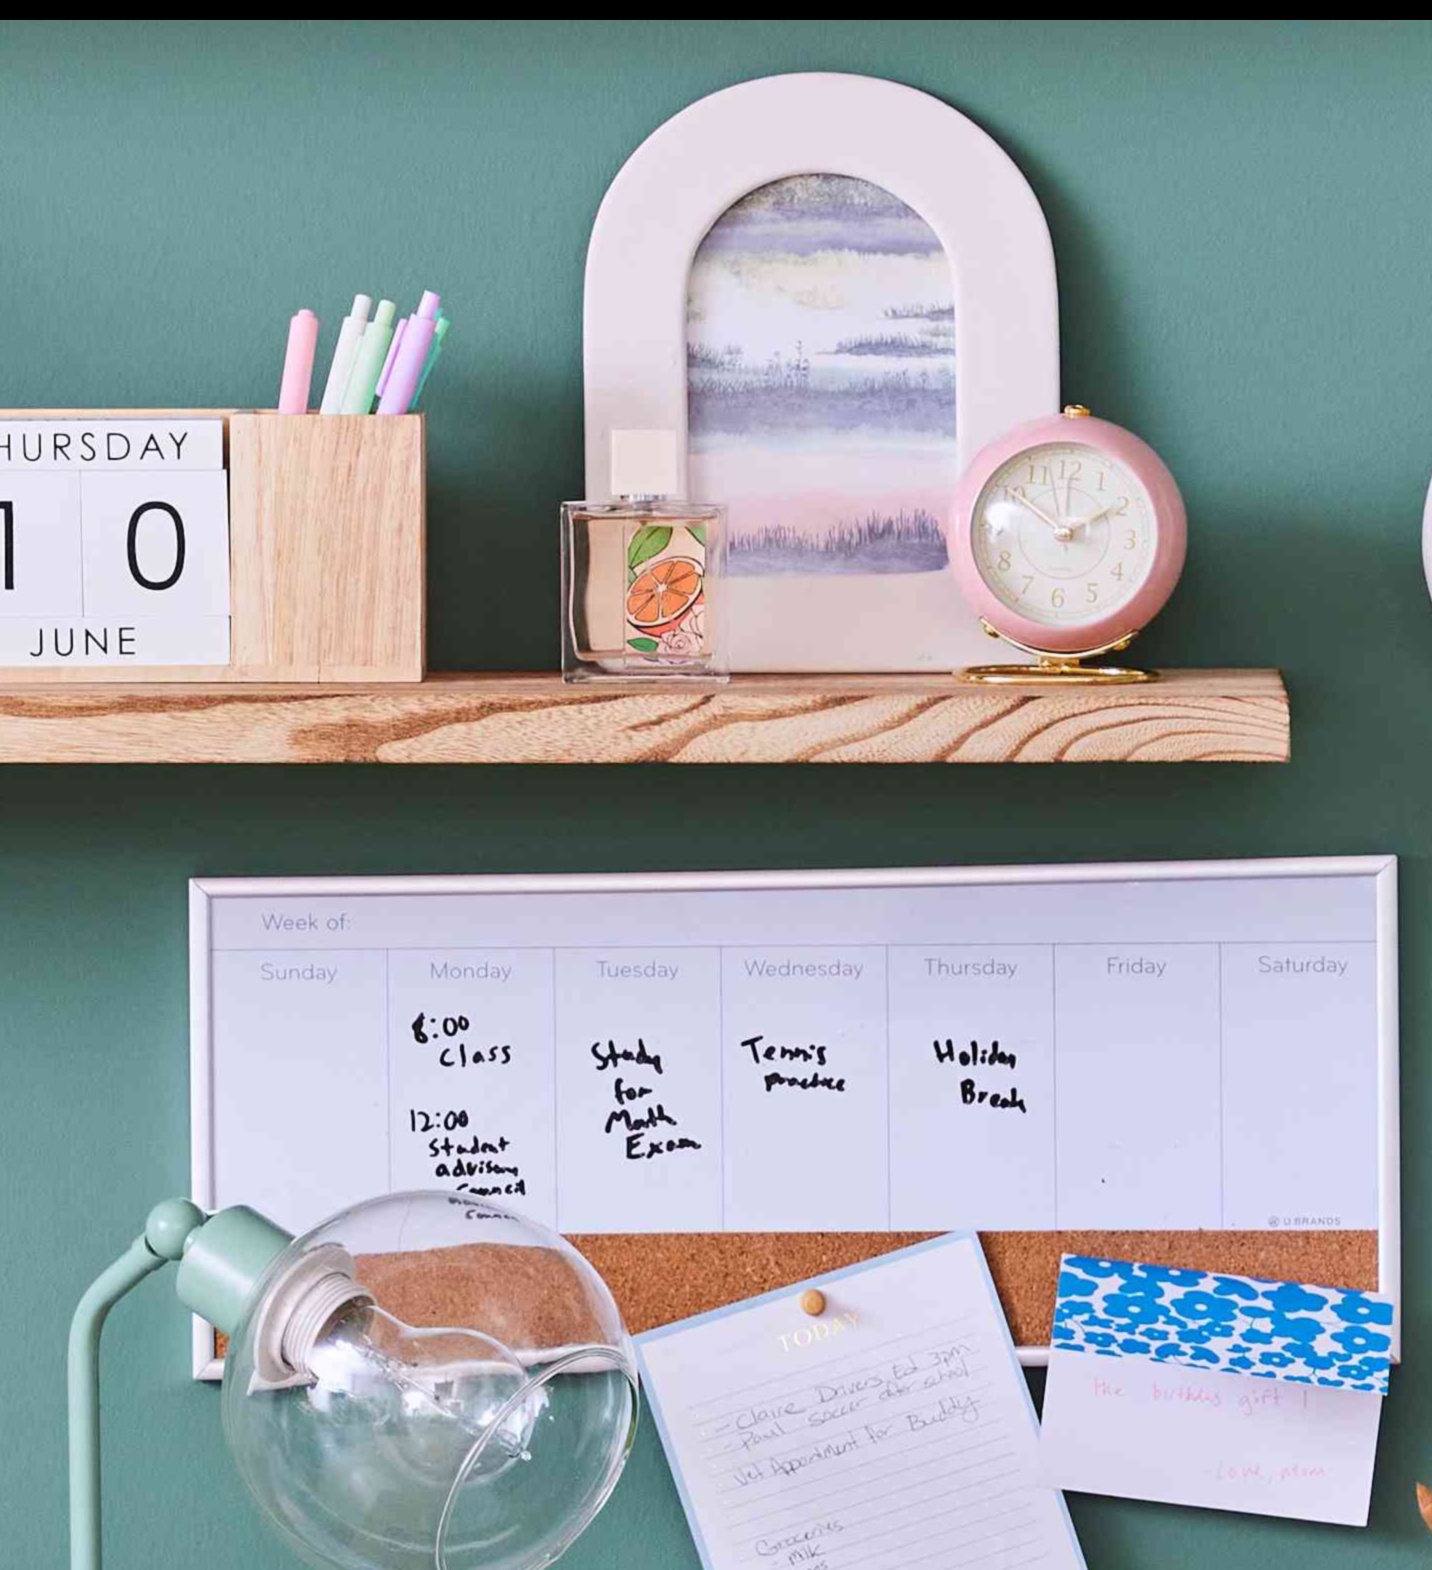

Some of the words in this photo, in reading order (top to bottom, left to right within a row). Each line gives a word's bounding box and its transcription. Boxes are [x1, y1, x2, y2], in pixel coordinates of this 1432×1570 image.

[1027, 464, 1048, 486] 11
[1058, 459, 1082, 481] 12
[1097, 471, 1105, 491] 1
[1116, 496, 1130, 517] 2
[1124, 530, 1137, 550] 3
[998, 549, 1011, 571] 8
[1110, 561, 1124, 582] 4
[1021, 575, 1035, 595] 7
[1087, 582, 1099, 603] 5
[1051, 587, 1065, 608] 6
[30, 627, 136, 657] JUNE
[261, 912, 318, 931] Week
[325, 912, 351, 931] of:
[260, 963, 338, 984] Sunday
[430, 961, 512, 982] Monday
[596, 959, 679, 980] Tuesday
[744, 958, 864, 979] Wednesday
[924, 957, 1018, 978] Thursday
[1106, 956, 1167, 976] Friday
[1258, 955, 1348, 975] Saturday
[411, 1012, 470, 1044] 8:00
[410, 1108, 469, 1132] 12:00
[778, 1311, 862, 1352] TODAY
